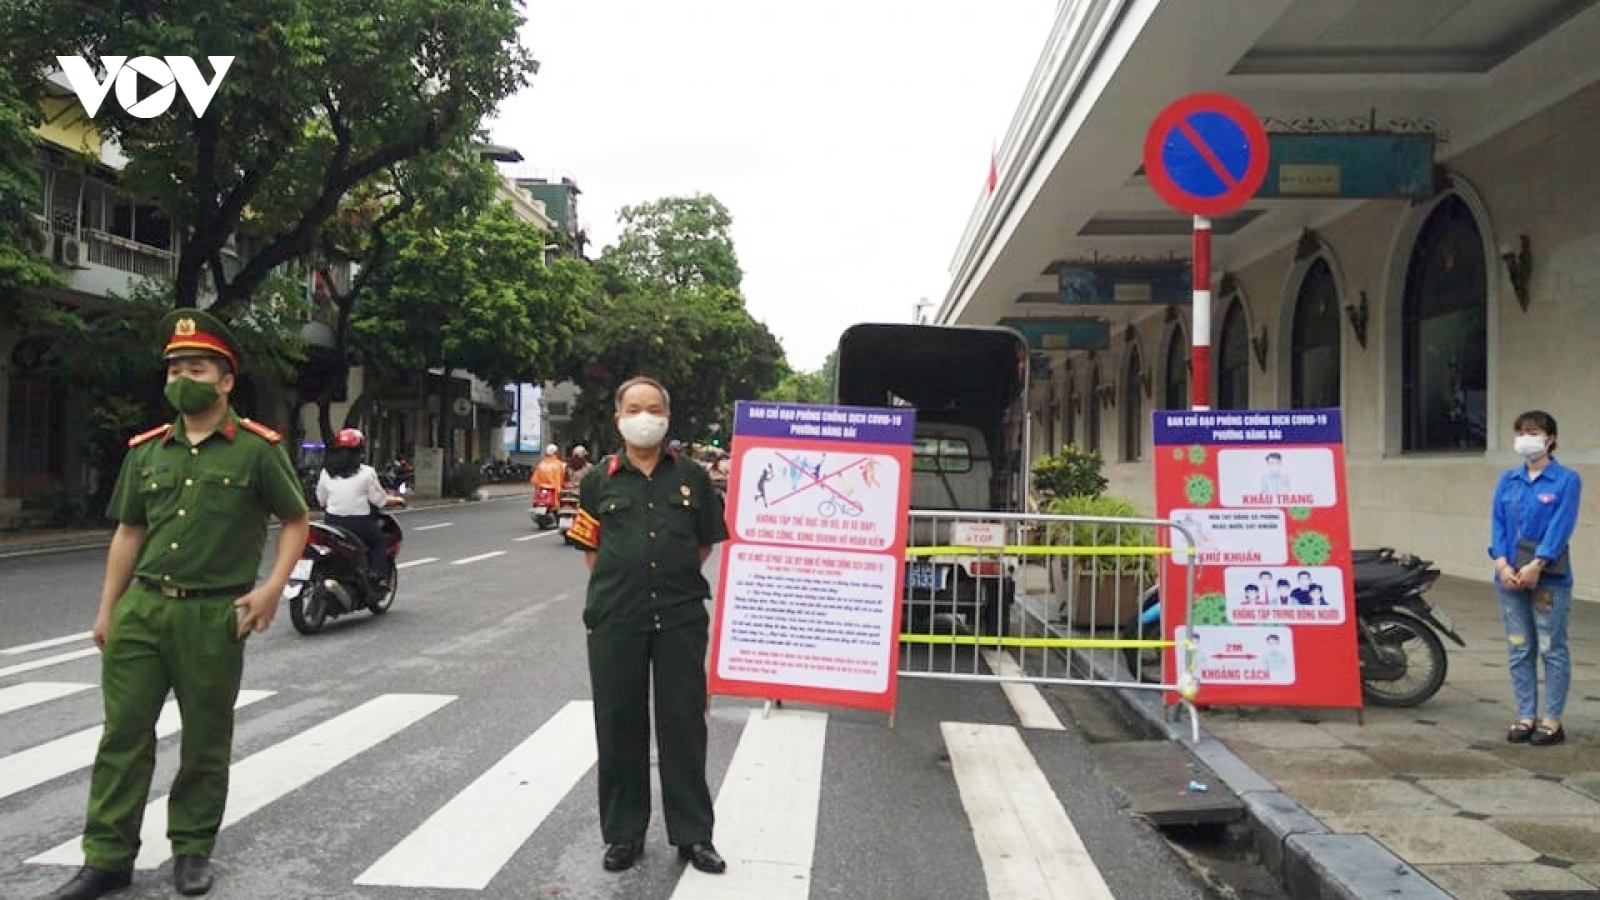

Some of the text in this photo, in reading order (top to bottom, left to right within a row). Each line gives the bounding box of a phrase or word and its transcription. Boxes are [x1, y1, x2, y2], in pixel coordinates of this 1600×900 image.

[749, 407, 765, 418] BAN
[867, 413, 902, 426] COVID-19
[1167, 416, 1184, 426] BAN
[1291, 415, 1327, 425] COVID-19
[1242, 492, 1314, 504] KHẨU TRANG
[1224, 549, 1261, 562] KHUẨN
[1232, 608, 1255, 620] KHÔNG
[1226, 643, 1242, 652] 2M
[1201, 665, 1270, 680] KHOẢNG CÁCH
